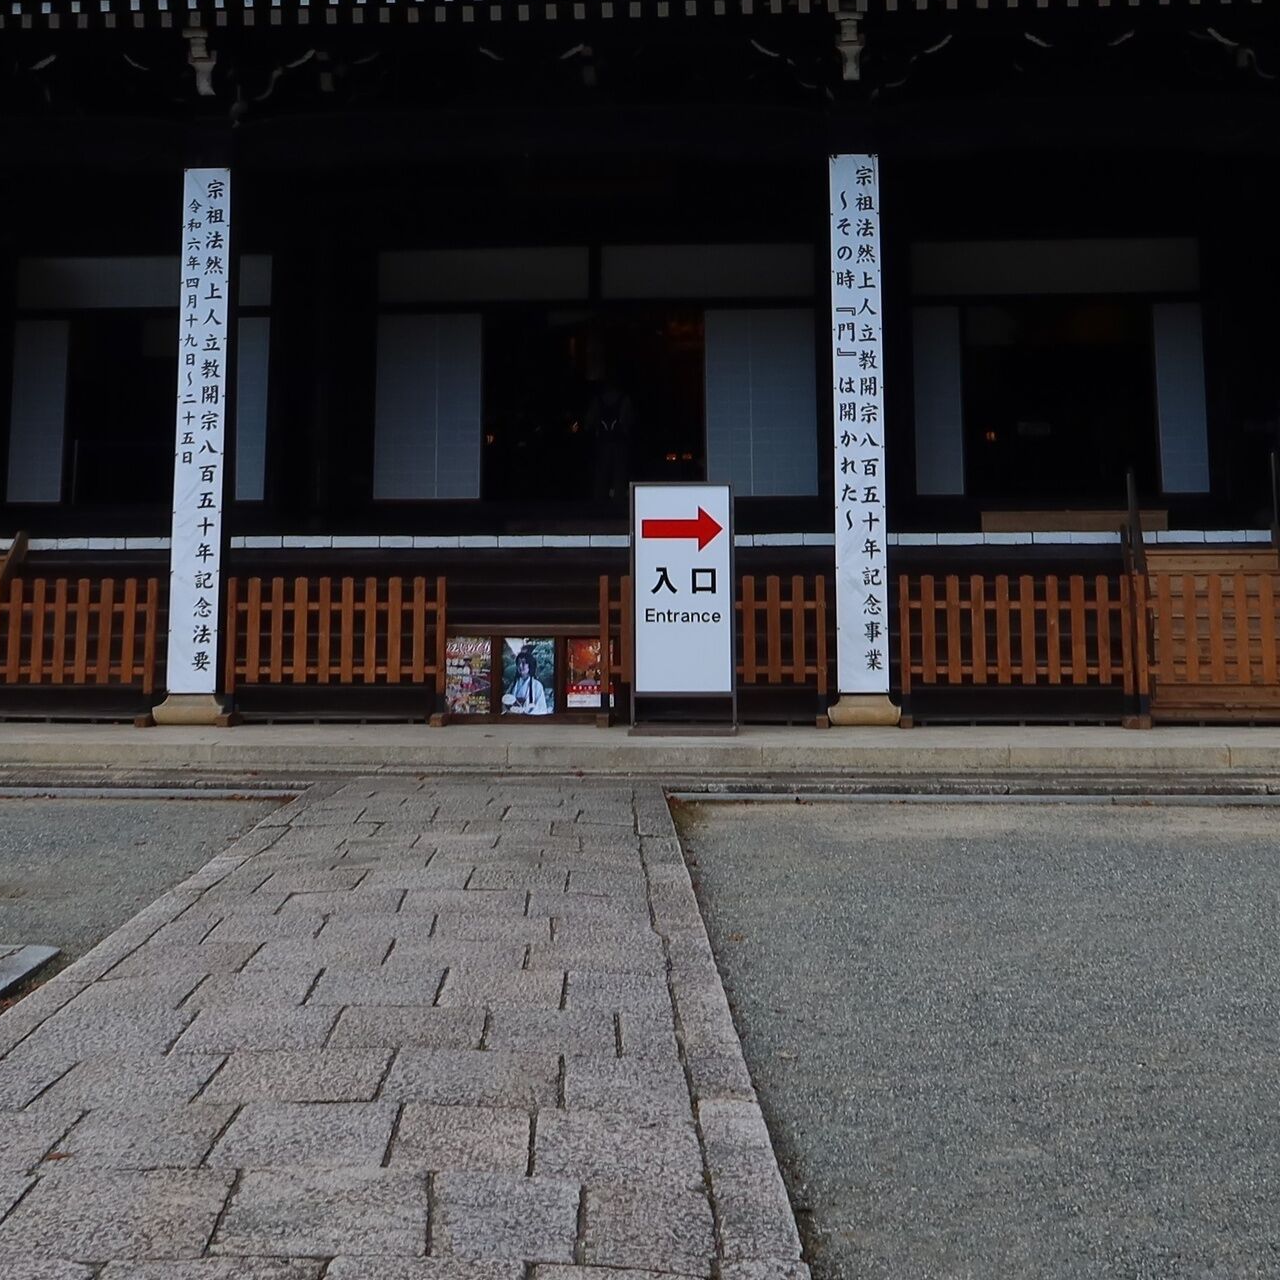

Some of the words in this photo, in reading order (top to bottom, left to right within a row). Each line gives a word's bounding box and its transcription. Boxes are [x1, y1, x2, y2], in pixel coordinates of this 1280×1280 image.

[191, 179, 225, 671] 宗祖法然上人立教開宗八百五十年記念法要
[855, 165, 883, 671] 宗祖法然上人立教開宗八百五十年記念事業
[645, 608, 721, 623] Entrance
[651, 567, 717, 594] 入口
